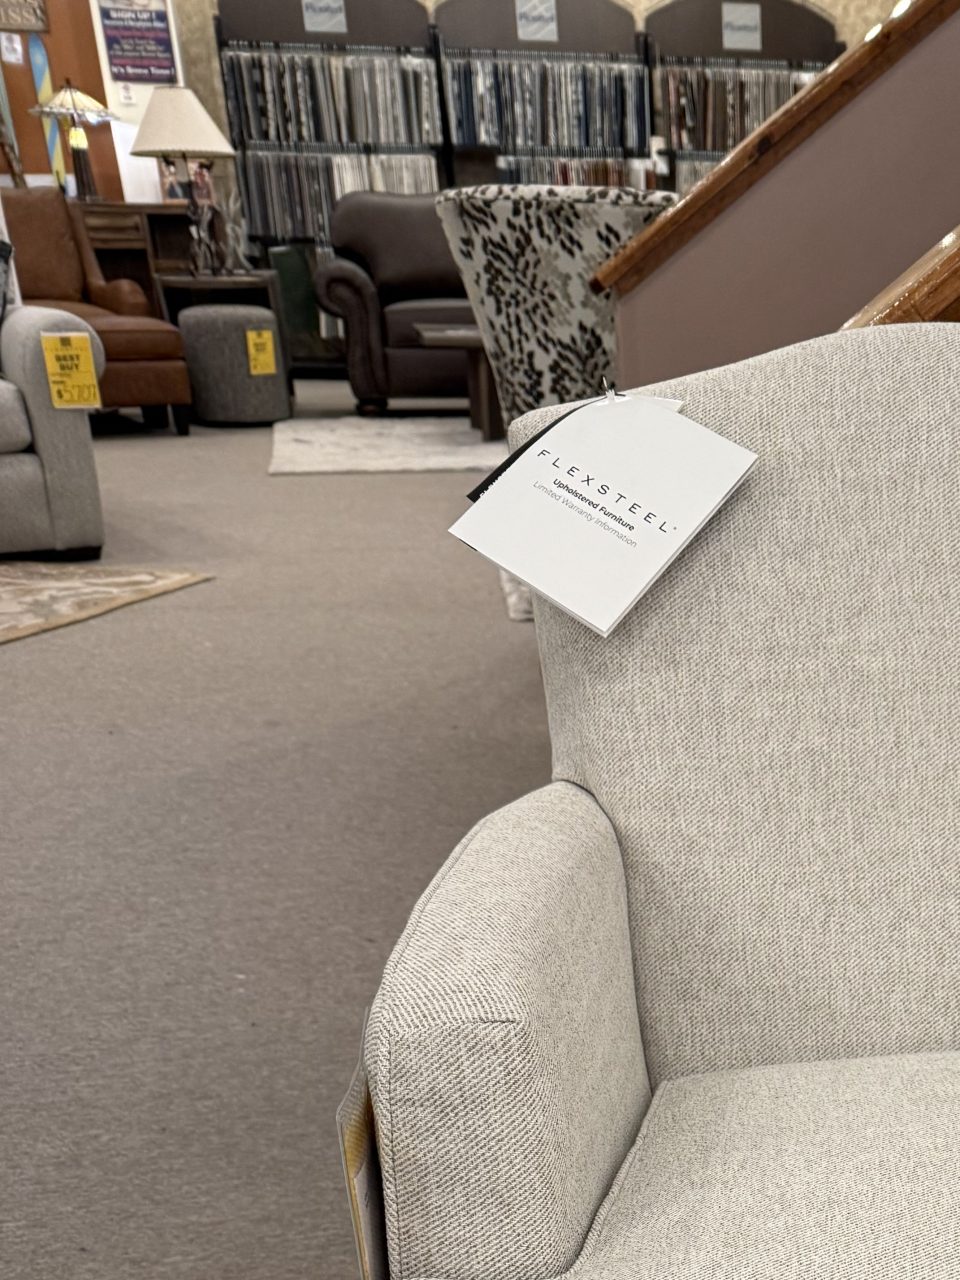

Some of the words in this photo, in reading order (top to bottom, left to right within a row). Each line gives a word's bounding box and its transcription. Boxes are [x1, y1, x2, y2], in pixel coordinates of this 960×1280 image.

[54, 354, 80, 362] BEST
[59, 362, 80, 371] BUY
[533, 480, 561, 501] Limited
[561, 497, 595, 522] Warranty
[594, 518, 638, 548] Information
[537, 449, 668, 533] FLEXSTEEL
[553, 478, 600, 509] Upholstered
[598, 506, 635, 531] Furniture
